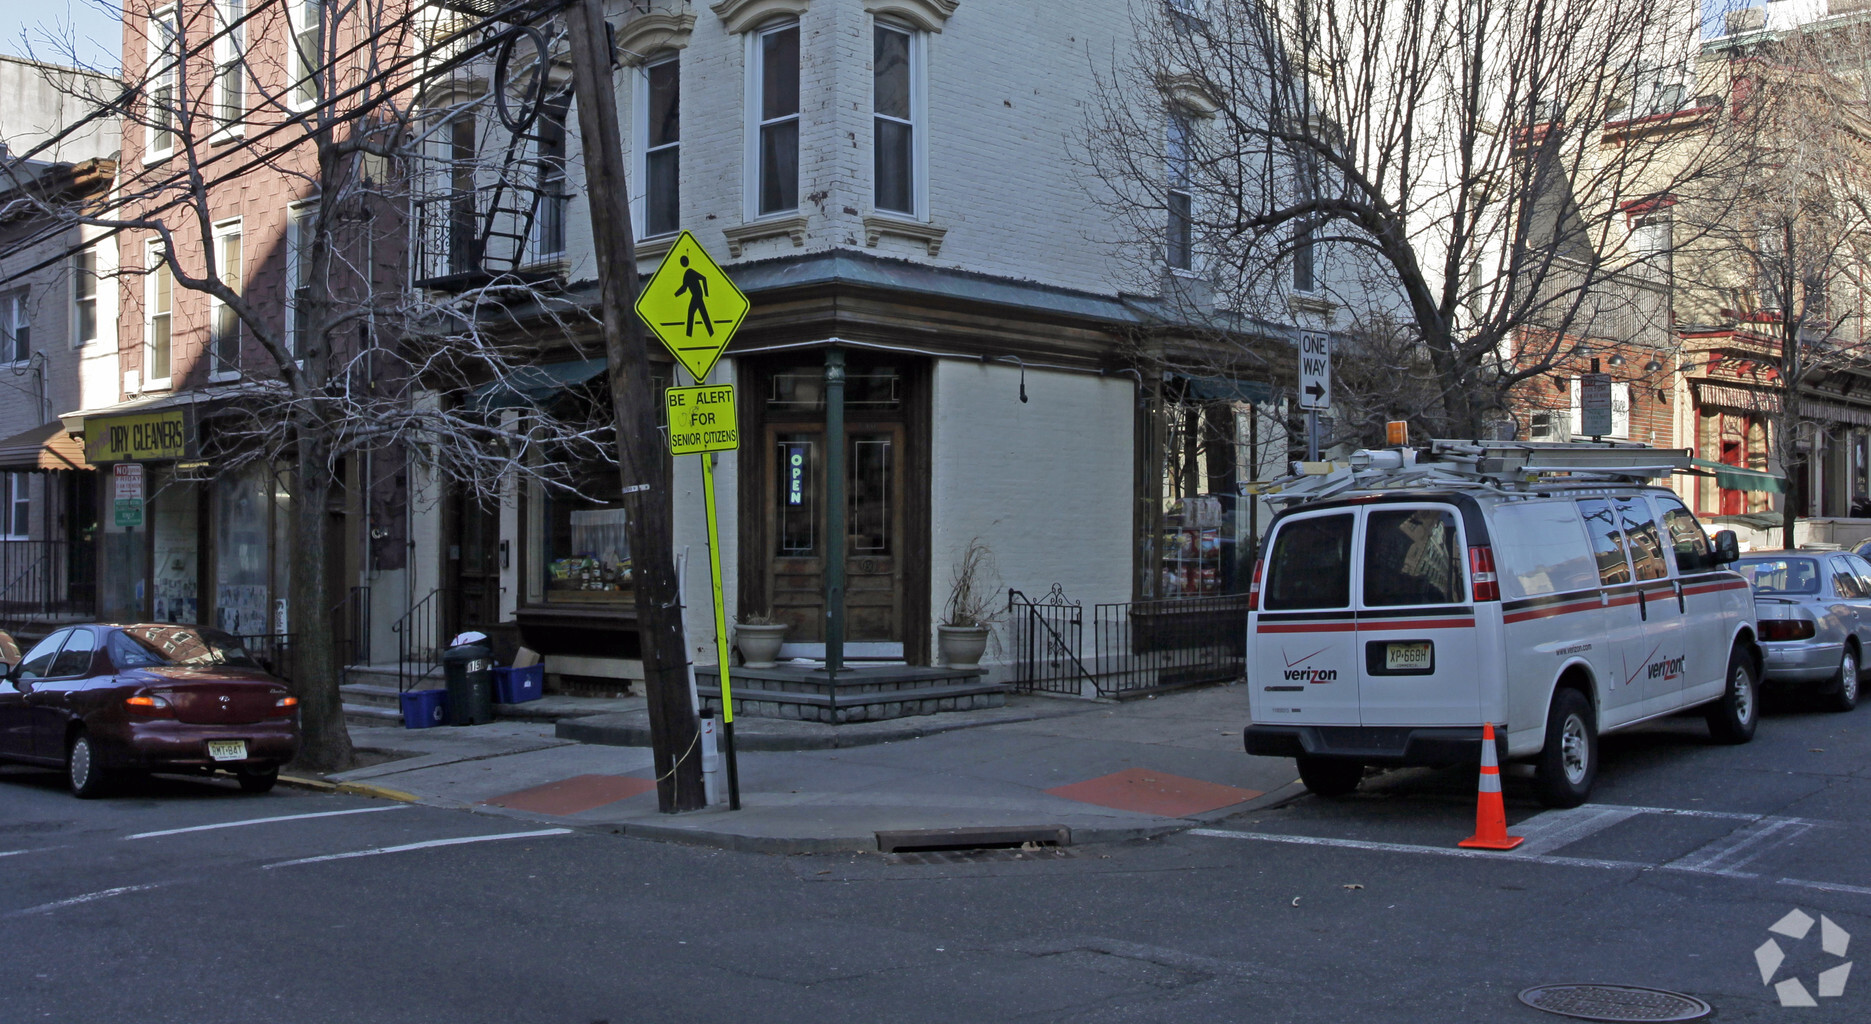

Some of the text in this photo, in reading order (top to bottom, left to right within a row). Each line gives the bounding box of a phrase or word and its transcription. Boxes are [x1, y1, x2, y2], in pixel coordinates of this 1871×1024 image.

[1303, 336, 1327, 355] ONE
[1303, 358, 1327, 376] WAY
[669, 390, 732, 407] BE ALERT
[690, 412, 716, 426] FOR
[110, 425, 130, 454] DRY
[133, 421, 183, 451] CLEANERS
[671, 429, 737, 447] SENIOR CITIZENS
[116, 466, 128, 475] NO
[791, 454, 803, 504] OPEN
[1556, 643, 1593, 656] www.verizon.com
[1284, 666, 1337, 684] verizon
[1648, 656, 1684, 681] verizon
